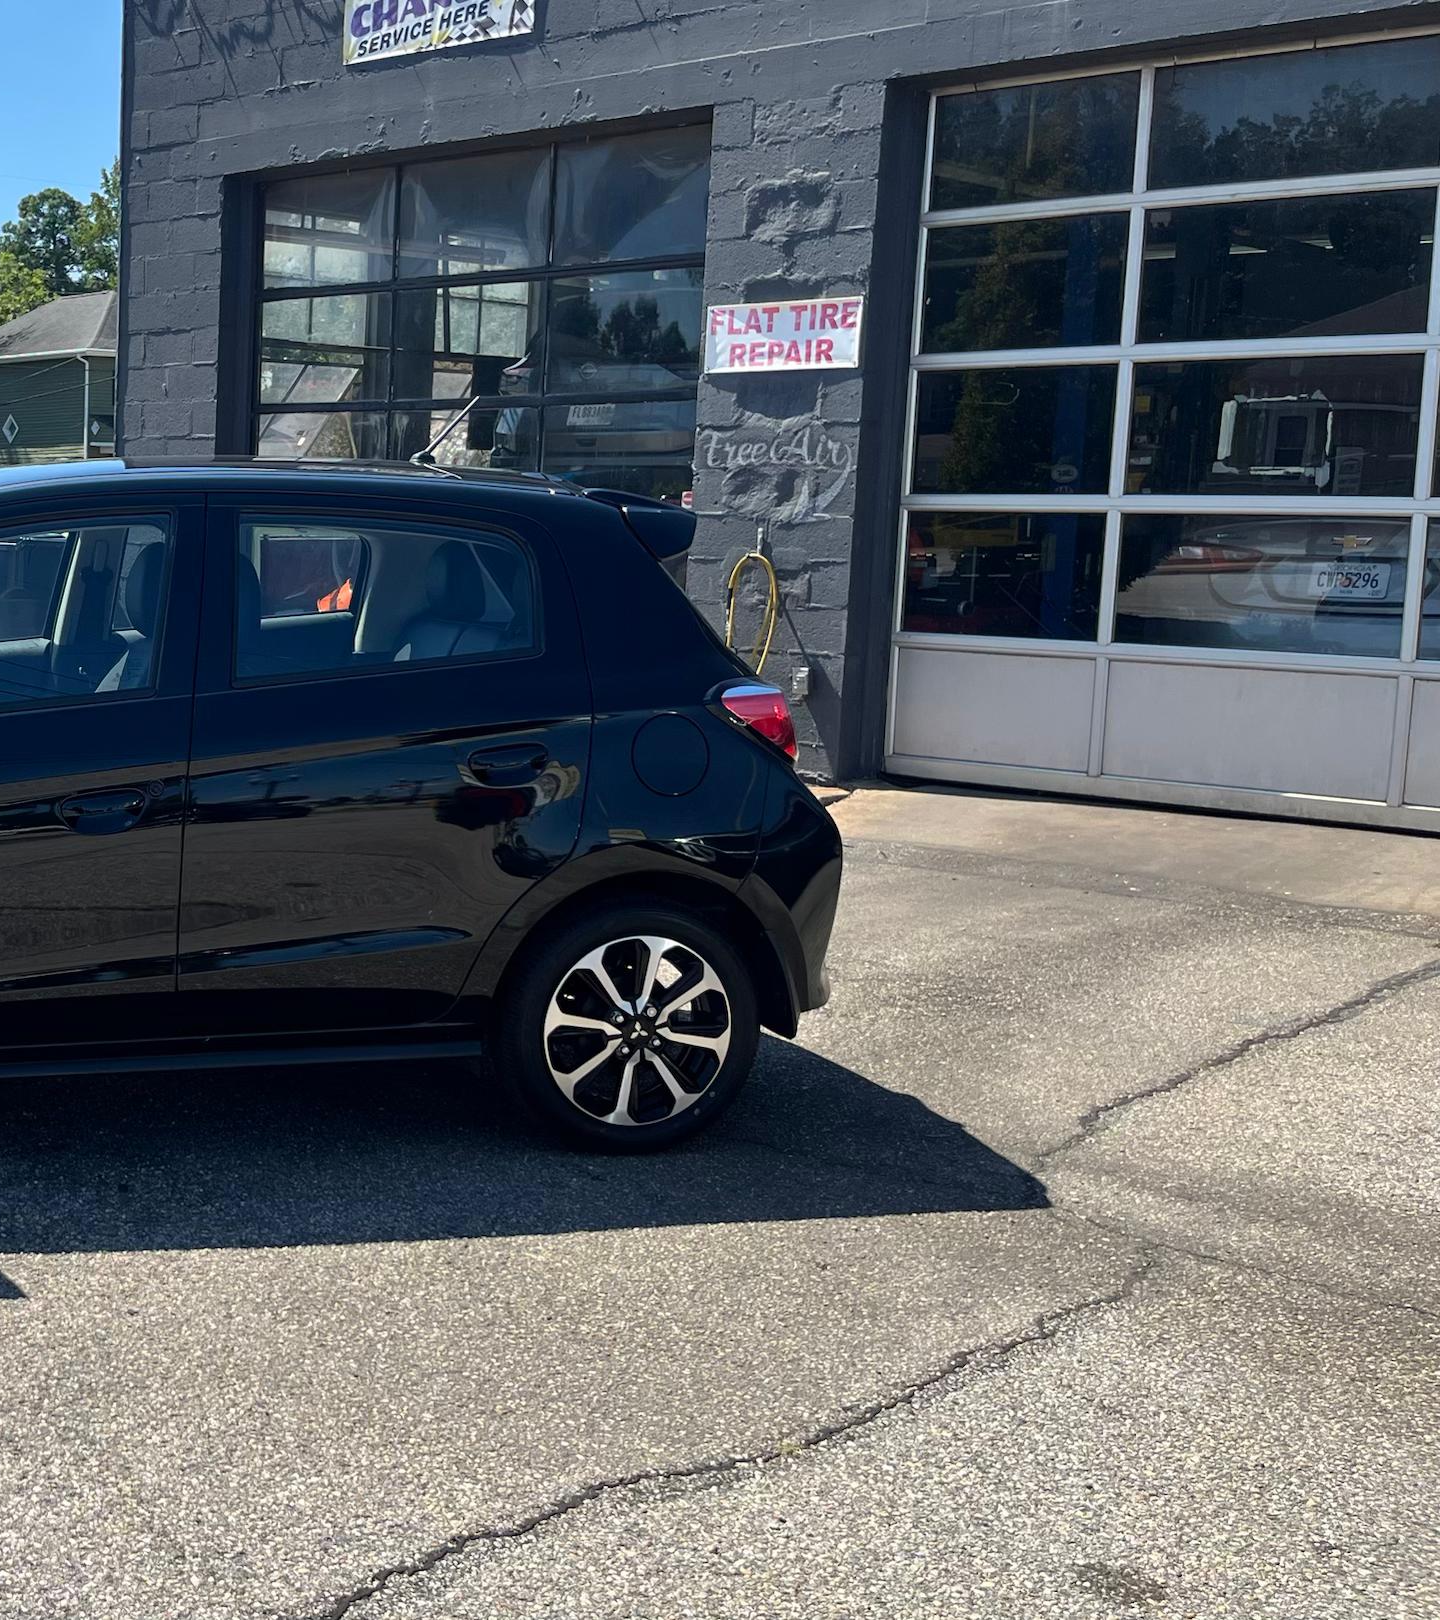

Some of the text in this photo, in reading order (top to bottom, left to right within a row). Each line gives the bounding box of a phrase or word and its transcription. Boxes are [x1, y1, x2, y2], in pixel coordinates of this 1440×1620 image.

[357, 0, 490, 58] SERVICE HERE
[710, 301, 859, 336] FLAT TIRE
[729, 338, 834, 367] REPAIR
